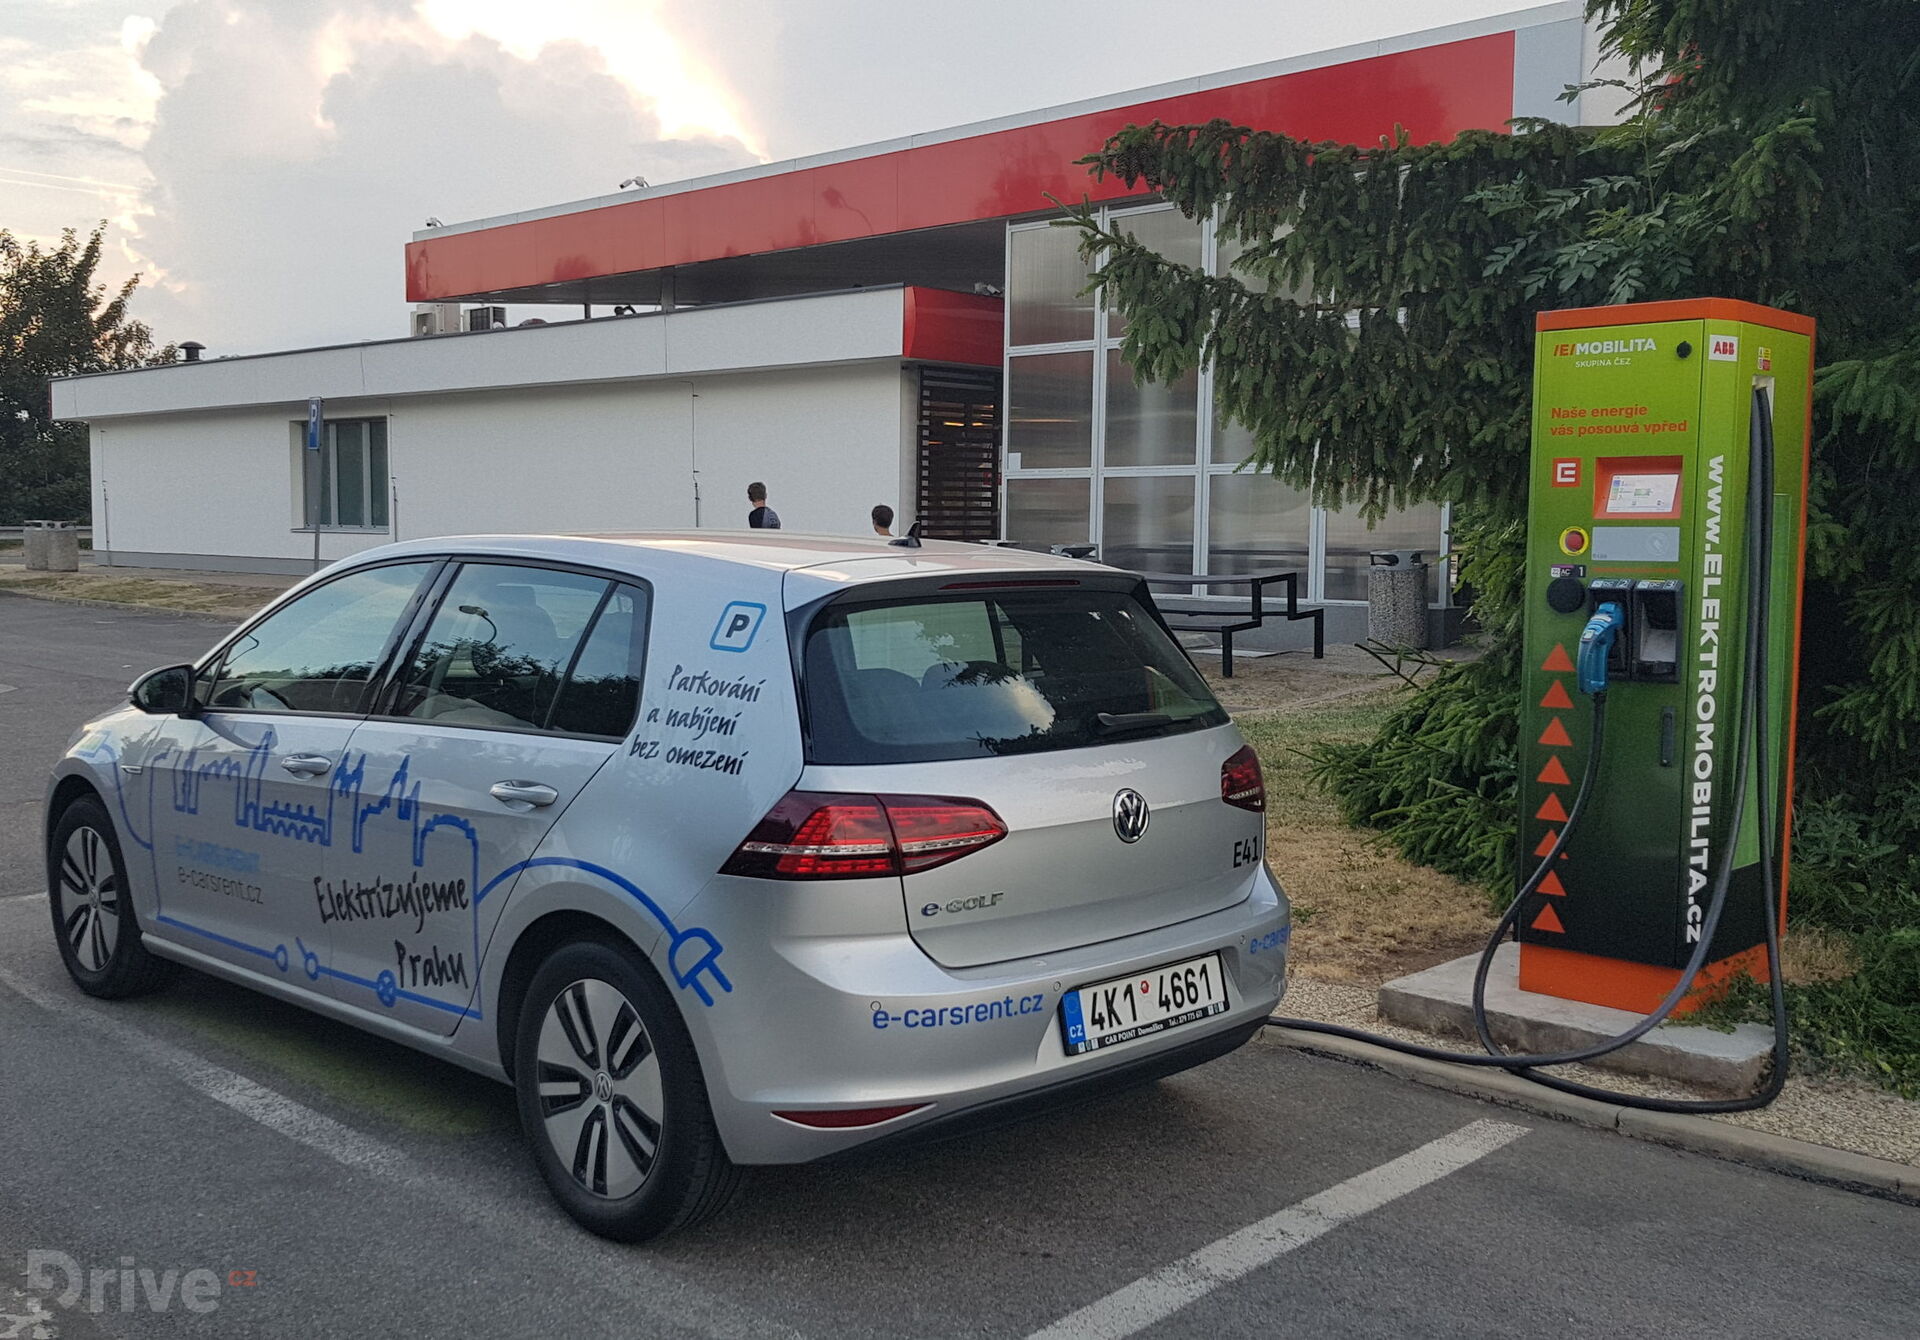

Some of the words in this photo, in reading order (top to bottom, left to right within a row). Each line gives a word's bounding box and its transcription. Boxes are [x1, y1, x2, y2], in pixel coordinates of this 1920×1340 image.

[1575, 358, 1611, 368] SKUPINA
[1614, 357, 1632, 366] ČEZ
[1713, 341, 1735, 355] ABB
[1551, 406, 1587, 419] Naše
[1591, 404, 1648, 418] energie
[1550, 424, 1574, 436] vás
[1578, 422, 1639, 437] posouvá
[1644, 420, 1687, 434] vpřed
[725, 613, 750, 638] P
[667, 664, 767, 702] Parkování
[647, 707, 660, 723] a
[666, 706, 743, 740] nabíjení
[629, 734, 660, 759] bez
[666, 747, 749, 775] omezení
[1233, 836, 1258, 868] E41
[178, 866, 264, 904] e-carsrent.cz
[314, 871, 469, 934] Elektrizujeme
[394, 939, 469, 989] Prahu
[873, 994, 1044, 1029] e-carsrent.cz
[1091, 983, 1137, 1030] 4K1
[1158, 963, 1212, 1012] 4661
[1069, 1025, 1083, 1038] CZ
[1104, 1035, 1118, 1045] CAR
[1118, 1029, 1136, 1041] POINT
